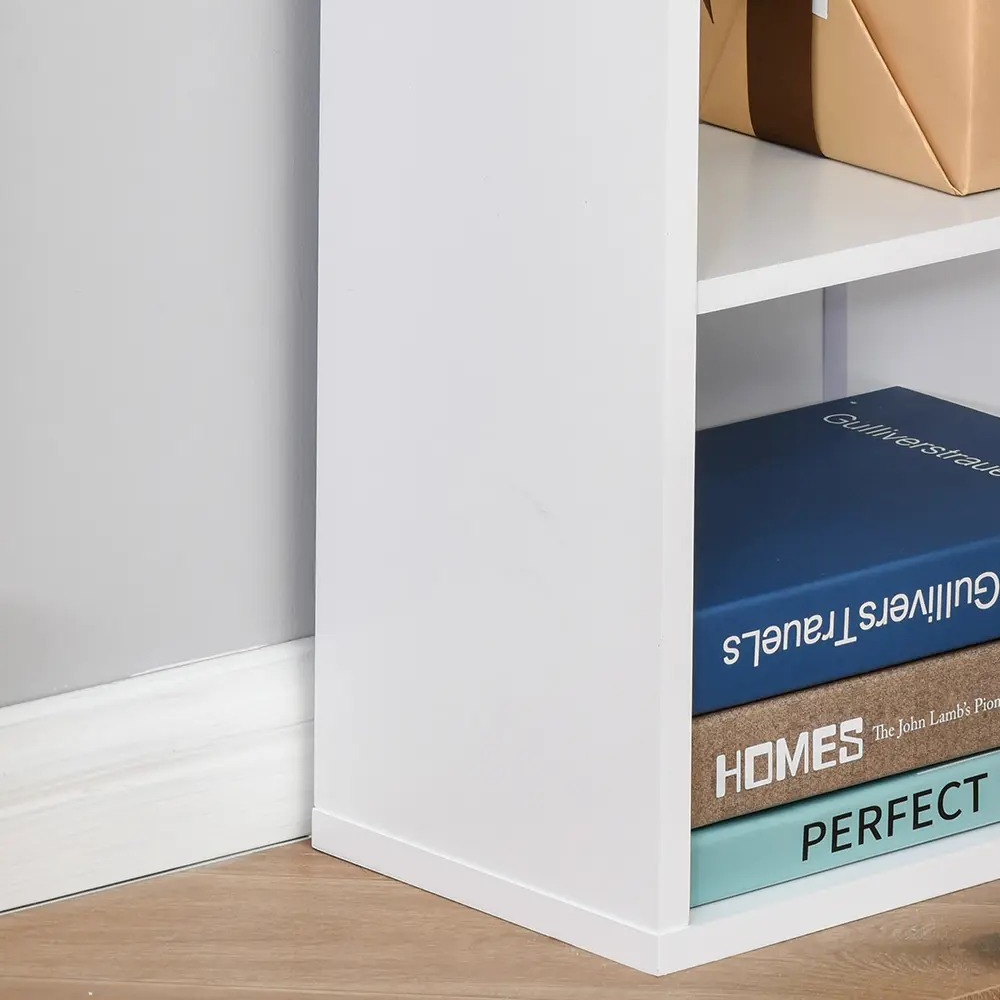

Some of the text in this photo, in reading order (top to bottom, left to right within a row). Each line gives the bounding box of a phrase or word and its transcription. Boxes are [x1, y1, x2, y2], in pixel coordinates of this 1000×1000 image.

[716, 717, 864, 798] HOMES
[872, 724, 895, 741] The
[897, 716, 926, 739] John
[930, 703, 971, 727] Lamb's
[802, 773, 988, 862] PERFECT
